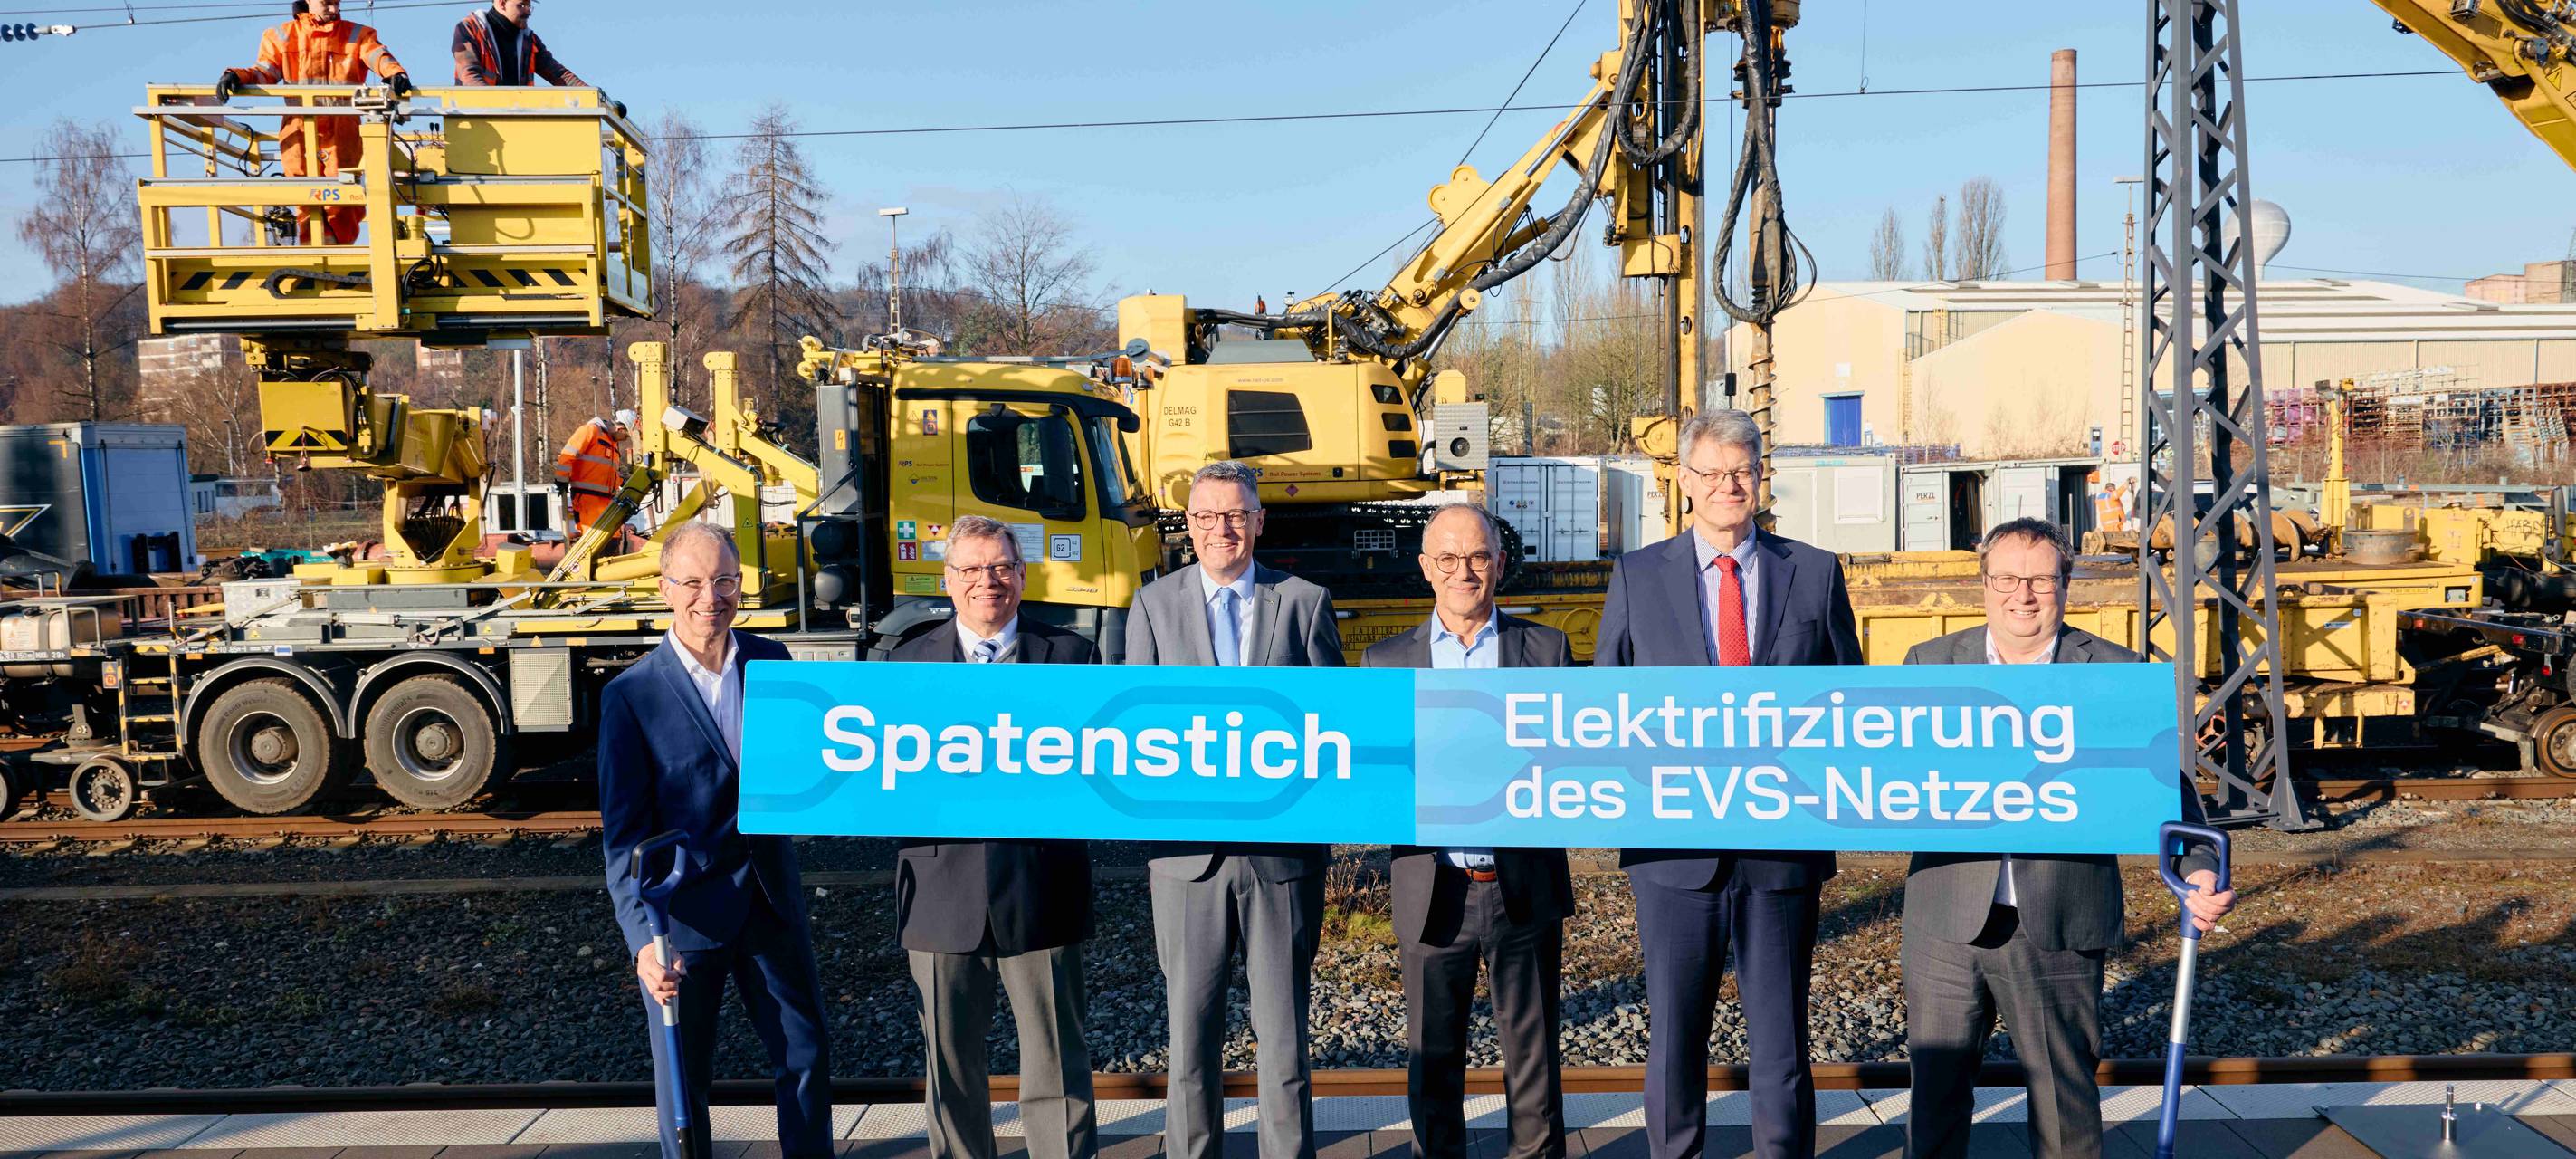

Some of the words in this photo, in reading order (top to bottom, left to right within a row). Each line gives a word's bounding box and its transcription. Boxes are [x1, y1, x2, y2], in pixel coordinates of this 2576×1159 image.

[310, 188, 341, 201] RPS
[1163, 406, 1197, 416] DELMAG
[1169, 418, 1183, 427] G42
[1185, 417, 1191, 426] B
[1916, 492, 1935, 500] PERZL
[1056, 543, 1065, 551] G2
[1505, 691, 2075, 764] Elektrifizierung
[822, 705, 1351, 790] Spatenstich
[1505, 765, 1627, 819] des
[1651, 765, 2078, 822] EVS-Netzes
